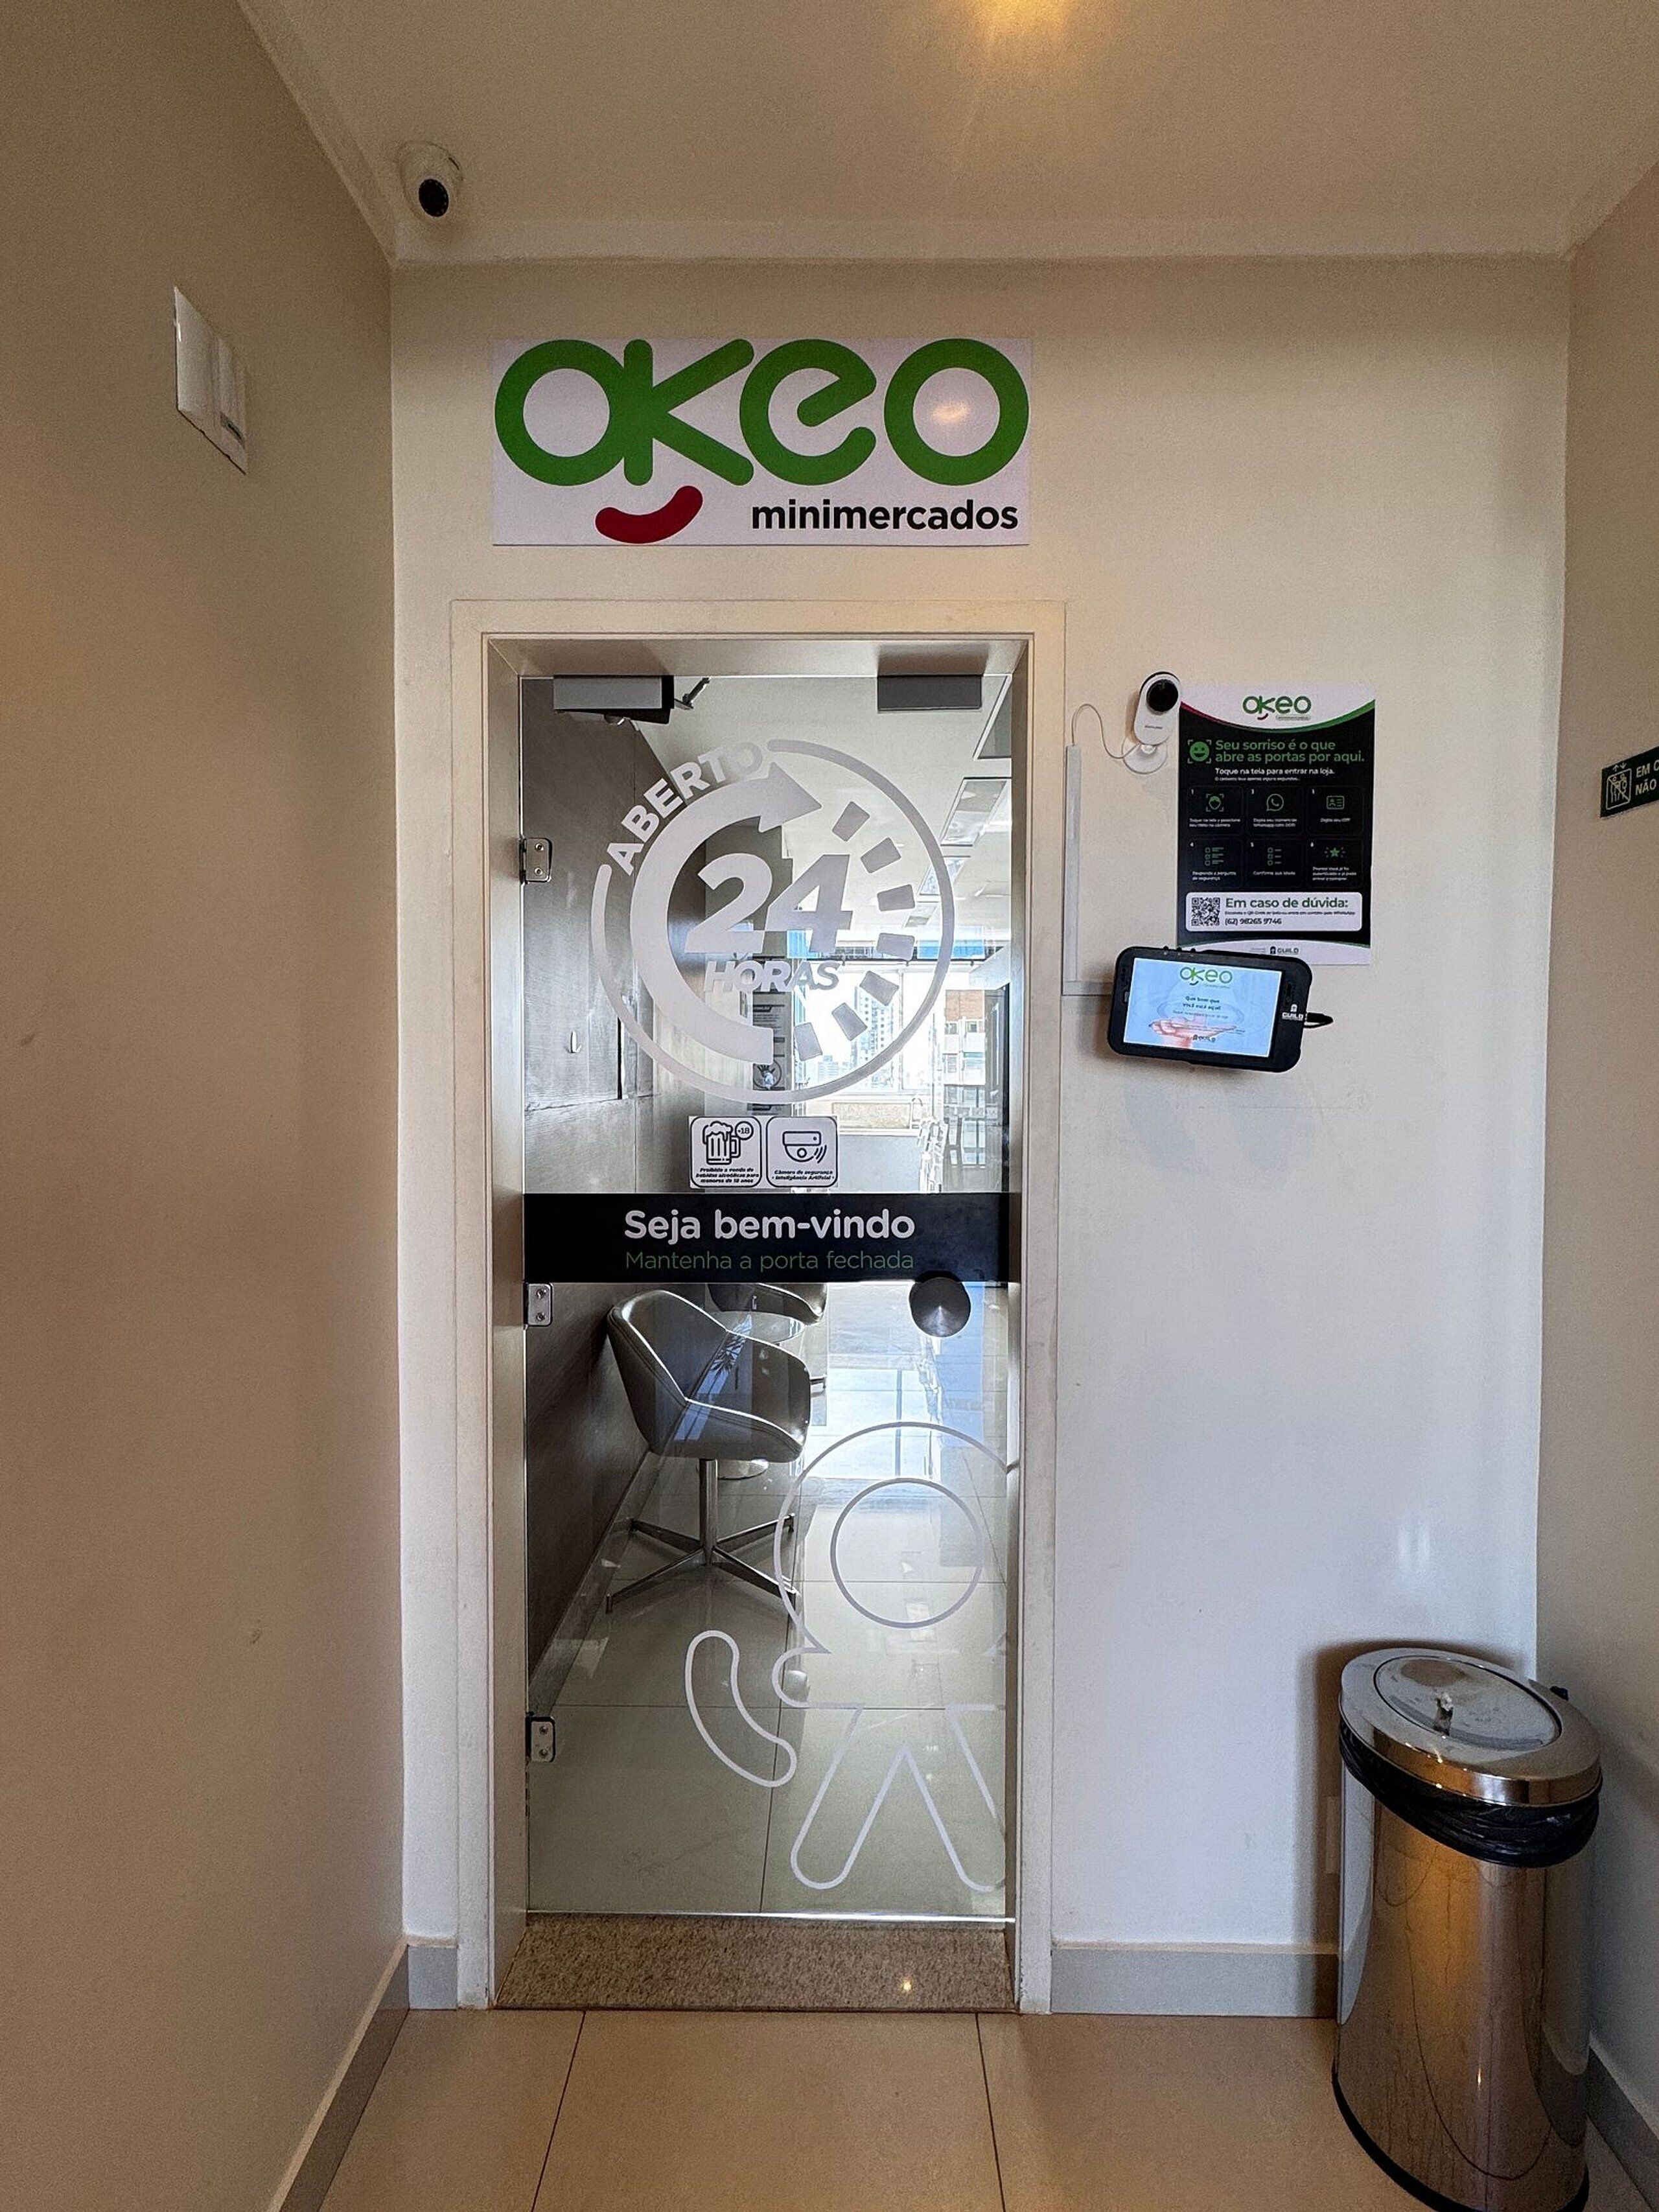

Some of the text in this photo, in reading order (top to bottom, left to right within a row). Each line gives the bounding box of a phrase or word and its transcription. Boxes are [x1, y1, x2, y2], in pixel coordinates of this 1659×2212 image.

[752, 499, 1019, 530] minimercados
[1215, 739, 1336, 754] Seu sorriso é o que
[1215, 751, 1365, 765] abre as portas por aqui.
[1215, 768, 1239, 776] Toque
[1320, 767, 1335, 776] loja.
[1636, 763, 1651, 778] EM
[1635, 778, 1657, 796] NÃO
[606, 741, 763, 876] ABERTO
[684, 852, 853, 954] 24
[1226, 897, 1349, 908] Em caso de dúvida:
[703, 960, 841, 992] HORAS
[625, 1209, 916, 1245] Seja bem-vindo
[625, 1250, 914, 1272] Mantenha a porta fechada
